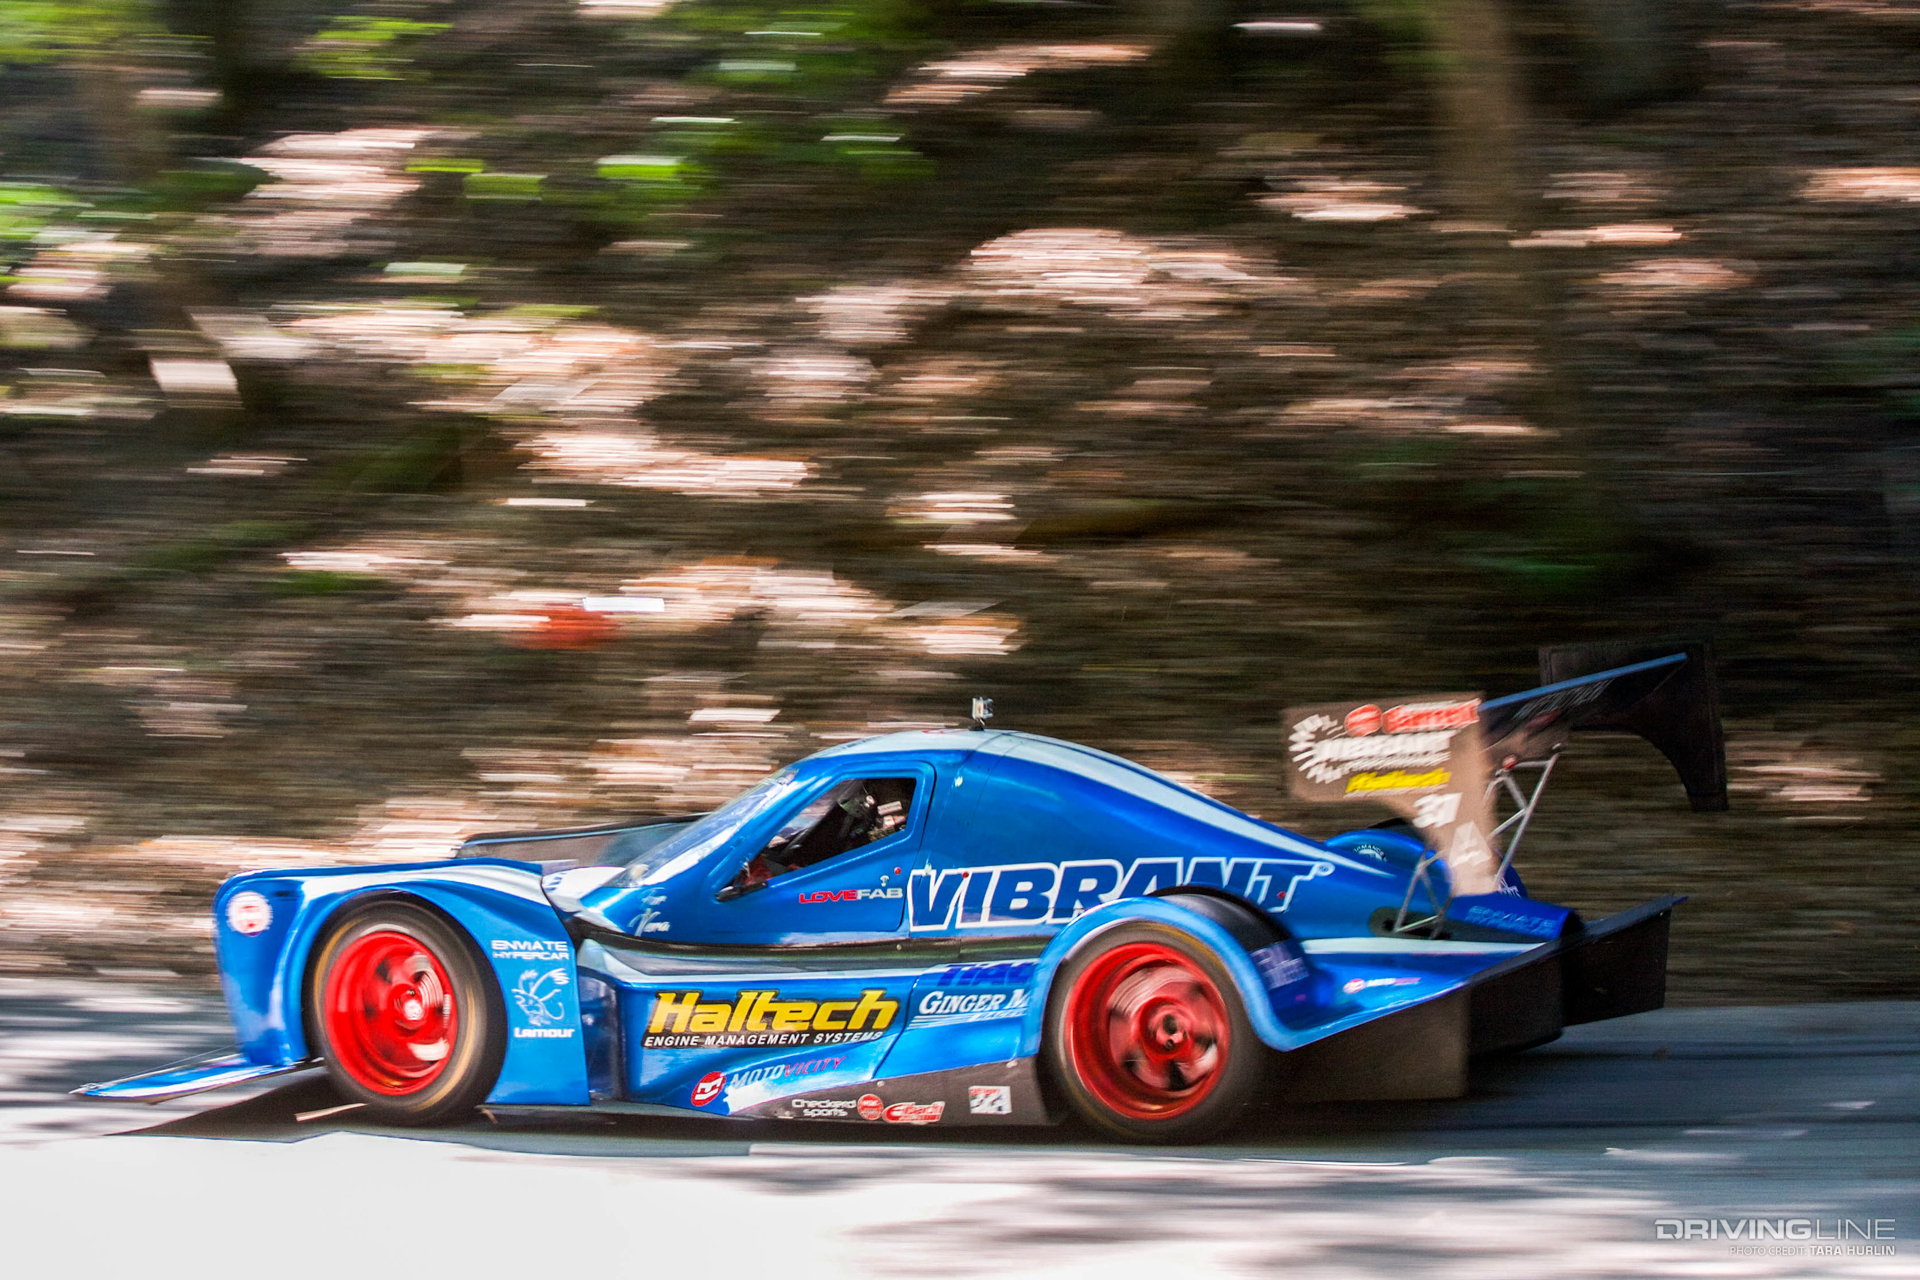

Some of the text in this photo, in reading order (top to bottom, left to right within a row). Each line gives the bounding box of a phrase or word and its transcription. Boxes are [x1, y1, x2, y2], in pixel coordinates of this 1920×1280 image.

[799, 888, 903, 903] LOVEFAB
[907, 856, 1318, 931] VIBRANT
[491, 940, 568, 951] ENVIATE
[492, 951, 569, 960] HYPERCAR
[649, 990, 898, 1033] Haltech
[919, 990, 1006, 1014] GINGER
[644, 1031, 884, 1047] ENGINE MANAGEMENT SYSTEMS
[730, 1055, 846, 1087] MOTOVICITY
